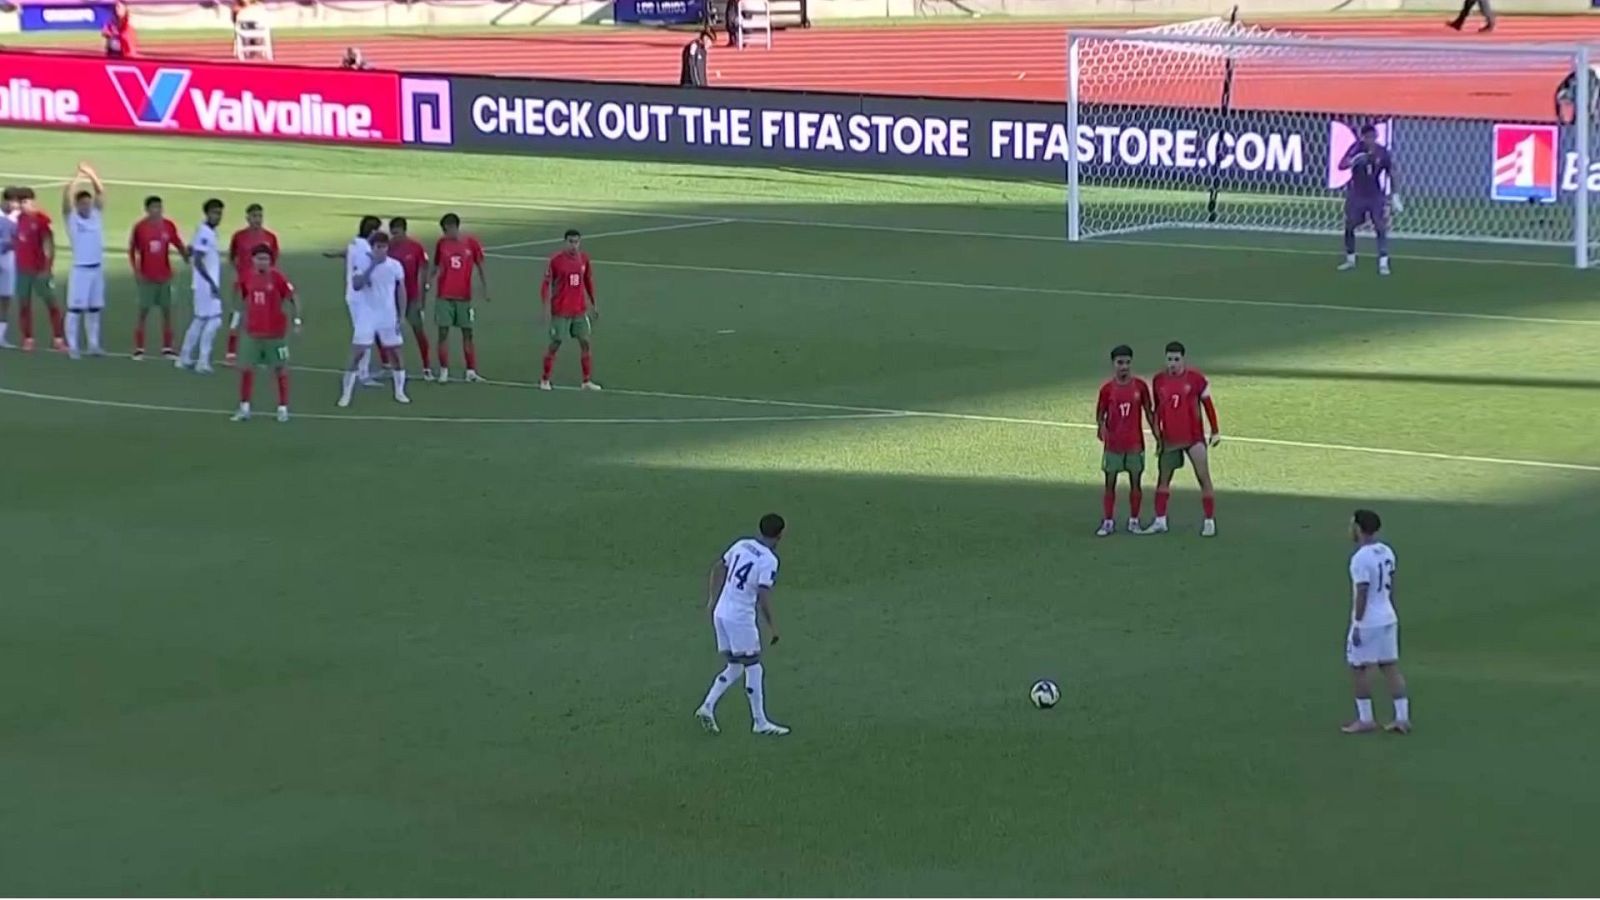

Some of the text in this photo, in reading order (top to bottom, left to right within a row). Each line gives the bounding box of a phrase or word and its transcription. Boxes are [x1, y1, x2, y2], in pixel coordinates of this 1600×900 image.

[190, 87, 372, 138] Valvoline
[472, 95, 593, 138] CHECK
[598, 102, 673, 142] OUT
[678, 106, 751, 146] THE
[849, 115, 969, 157] STORE
[991, 120, 1303, 173] FIFASTORE.COM
[1119, 402, 1131, 417] 17
[1172, 394, 1179, 408] 7
[728, 554, 754, 591] 14
[1377, 559, 1395, 592] 13
